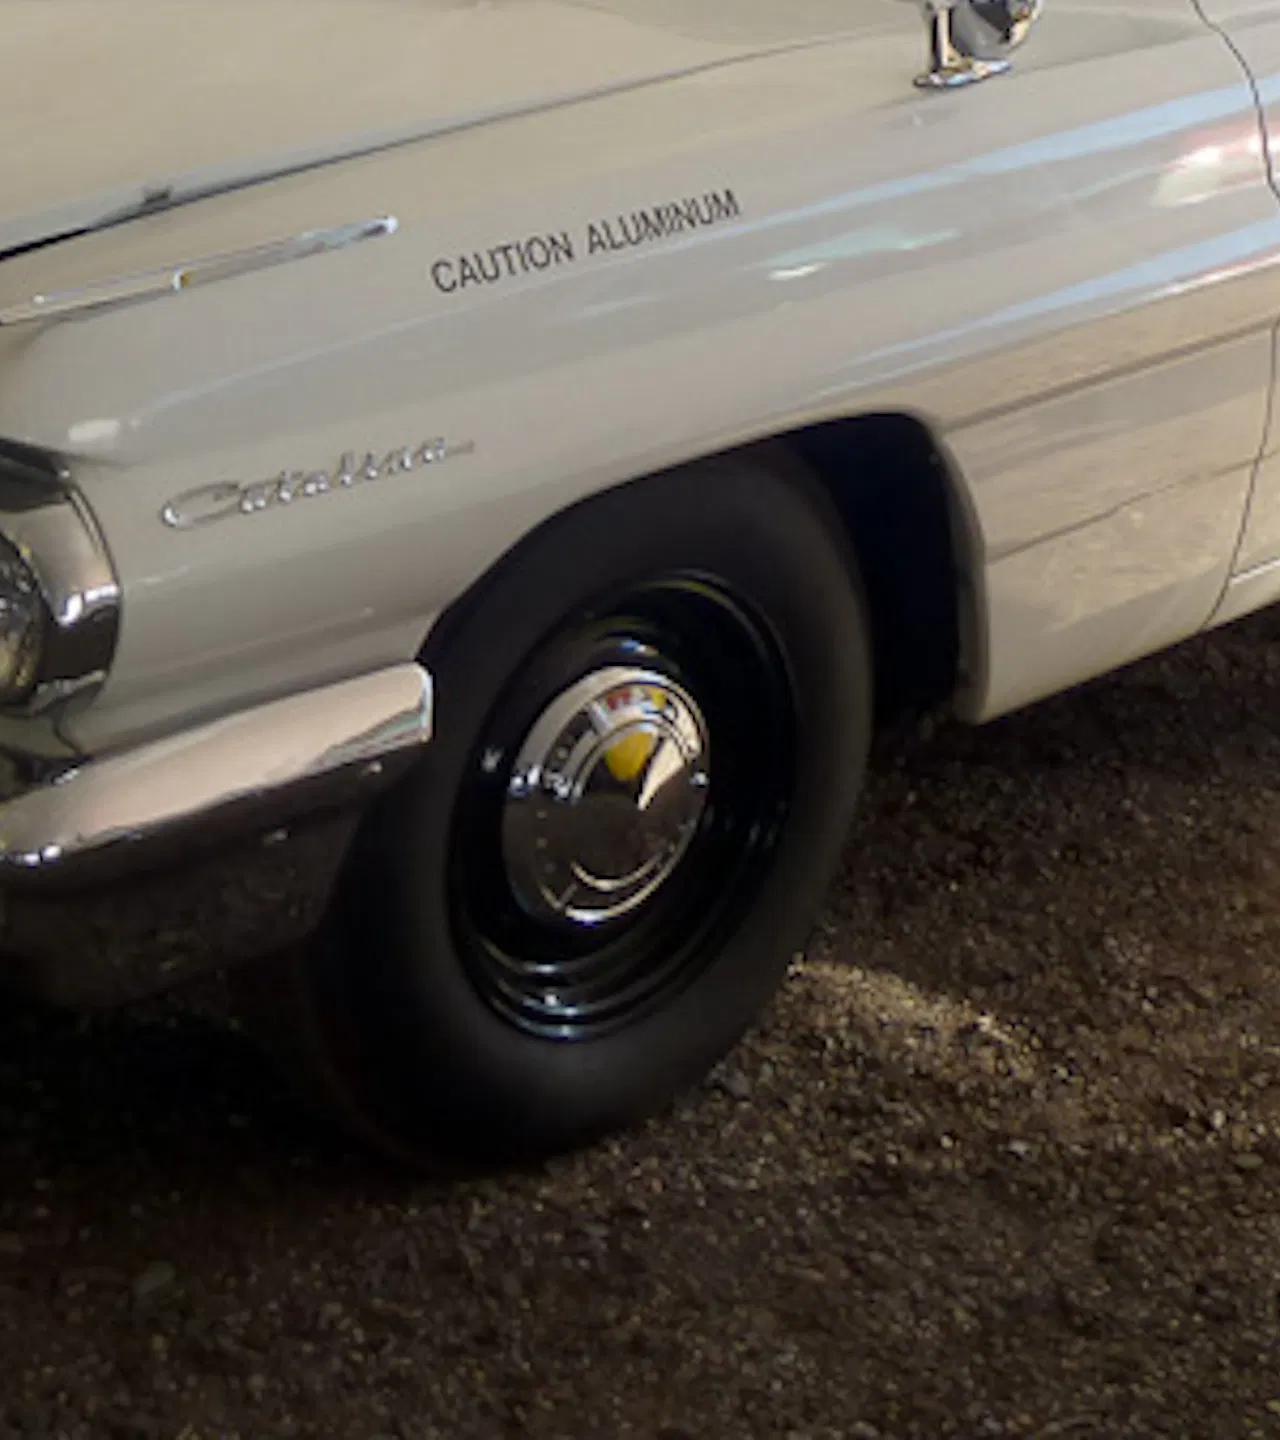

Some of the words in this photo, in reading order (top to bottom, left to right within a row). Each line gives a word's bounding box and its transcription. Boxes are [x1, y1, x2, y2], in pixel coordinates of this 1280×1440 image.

[431, 231, 575, 293] CAUTION
[578, 188, 741, 254] ALUMINUM
[162, 436, 476, 531] Catalina
